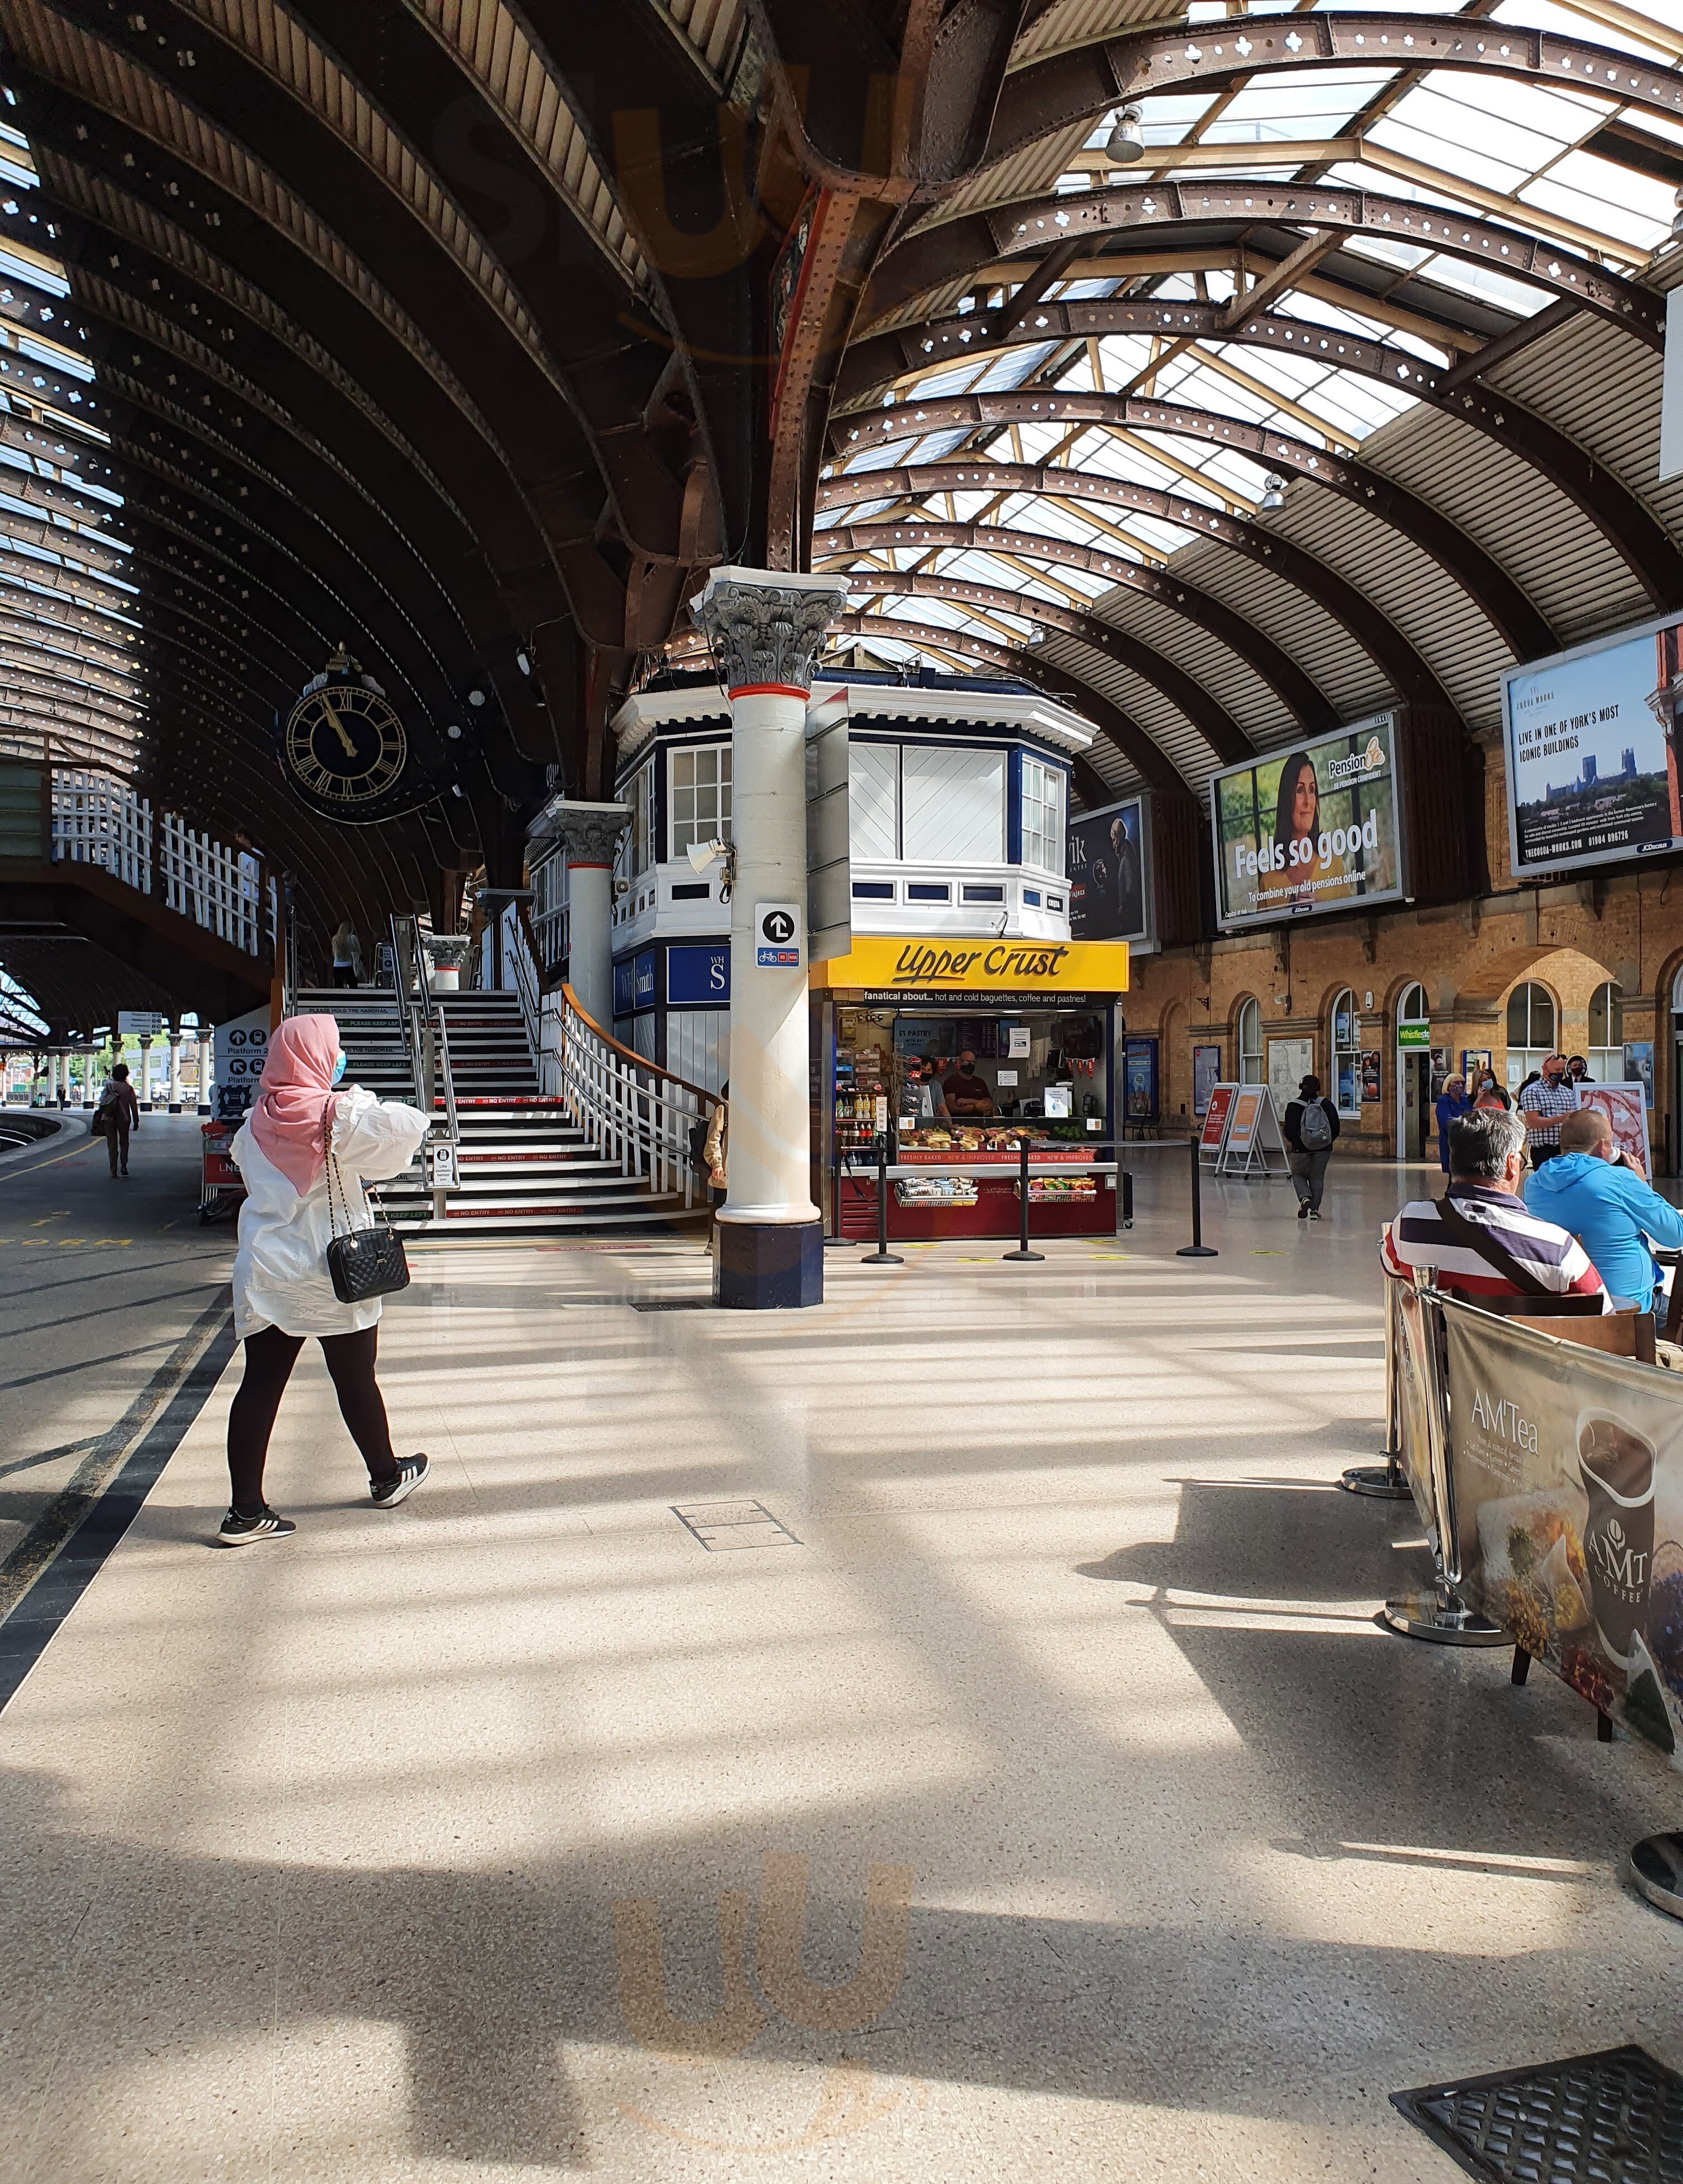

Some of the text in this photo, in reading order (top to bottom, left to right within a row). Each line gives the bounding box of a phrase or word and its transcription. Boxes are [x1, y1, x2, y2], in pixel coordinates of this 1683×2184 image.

[1536, 692, 1554, 704] WORKS
[1519, 704, 1619, 745] LIVE IN ONE OF YORK'S MOST
[1519, 735, 1579, 763] ICONIC BUILDINGS
[1235, 808, 1378, 879] Feels so good
[1588, 834, 1606, 846] 01904
[1248, 870, 1366, 903] To combine your old pensions online
[1048, 899, 1060, 908] COSTA
[710, 956, 724, 964] WH
[892, 944, 1069, 984] Upper Crust
[710, 964, 725, 989] S
[864, 991, 1086, 1004] fanatical about... hot and cold baguettes, coffee and pastries!
[219, 1162, 240, 1172] LNE
[1588, 1530, 1648, 1588] AMT
[1595, 1565, 1641, 1603] COFFEE
